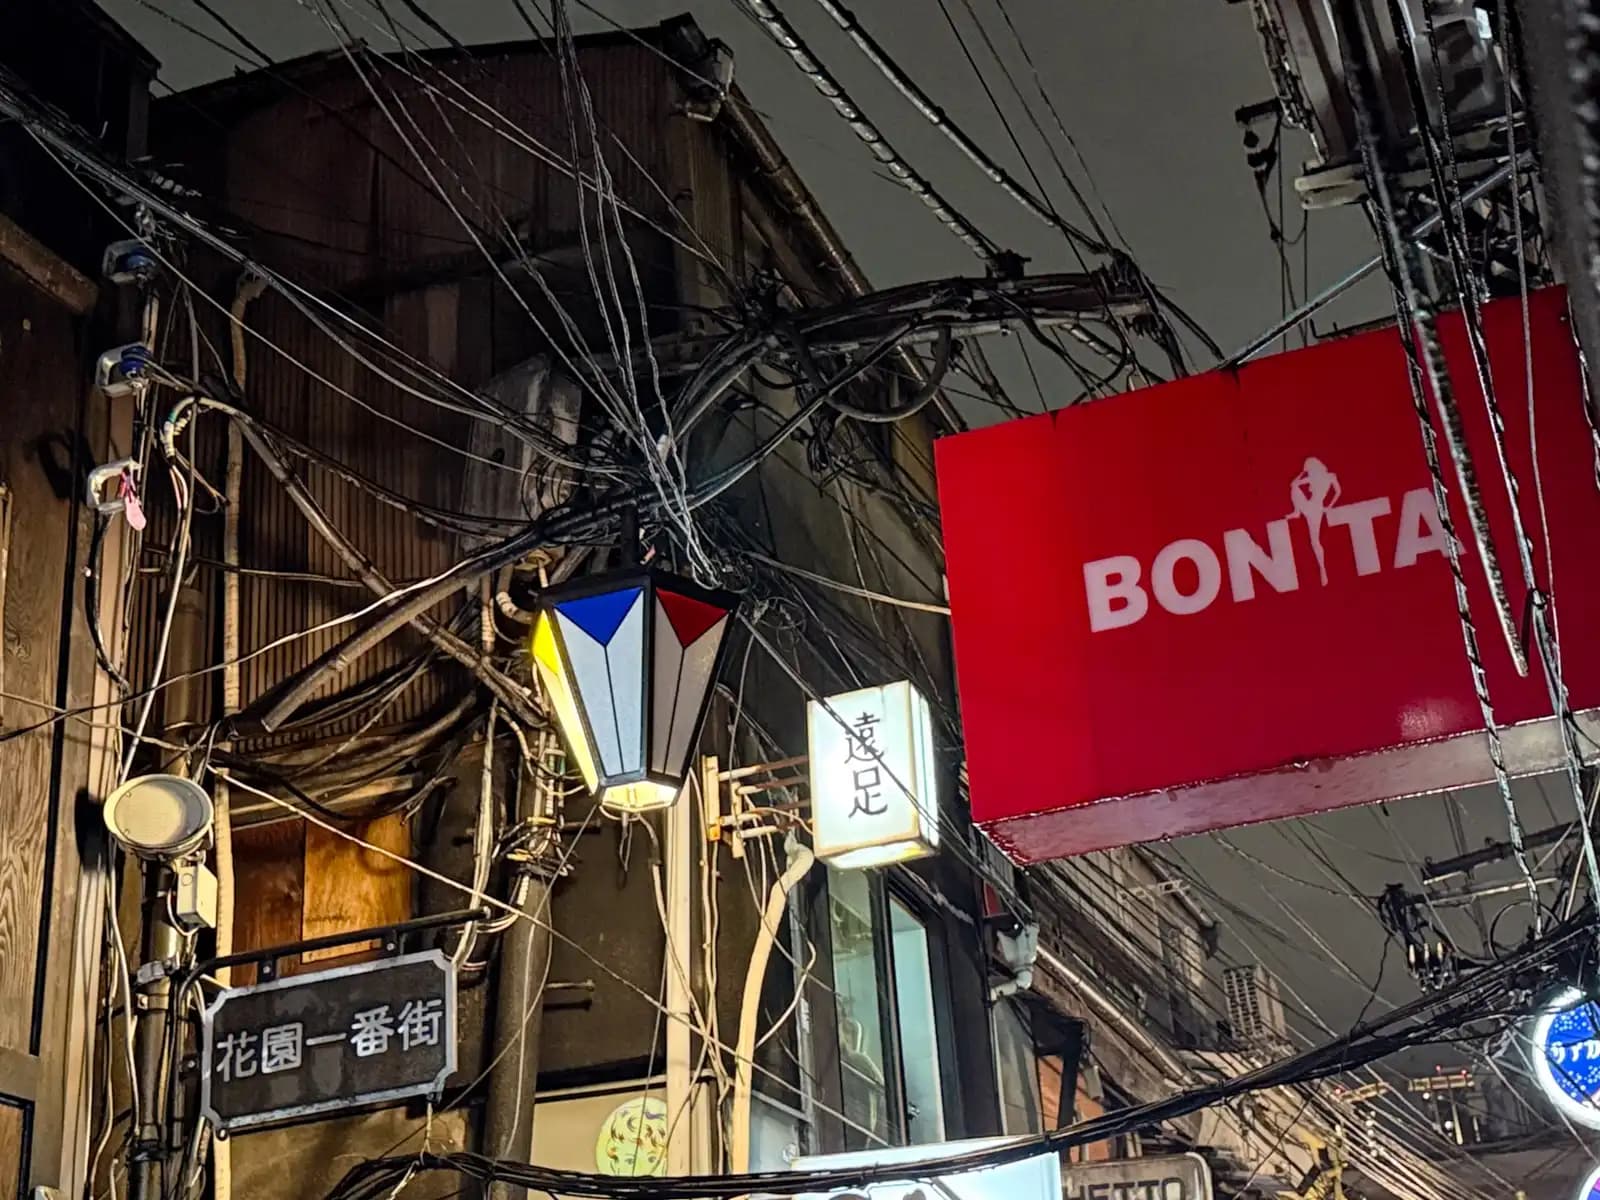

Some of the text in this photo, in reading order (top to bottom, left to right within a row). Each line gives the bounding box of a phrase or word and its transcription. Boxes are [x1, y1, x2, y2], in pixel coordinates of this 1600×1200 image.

[1083, 457, 1467, 633] BONITA
[844, 711, 889, 819] 遠足
[216, 999, 443, 1083] 花園一番街
